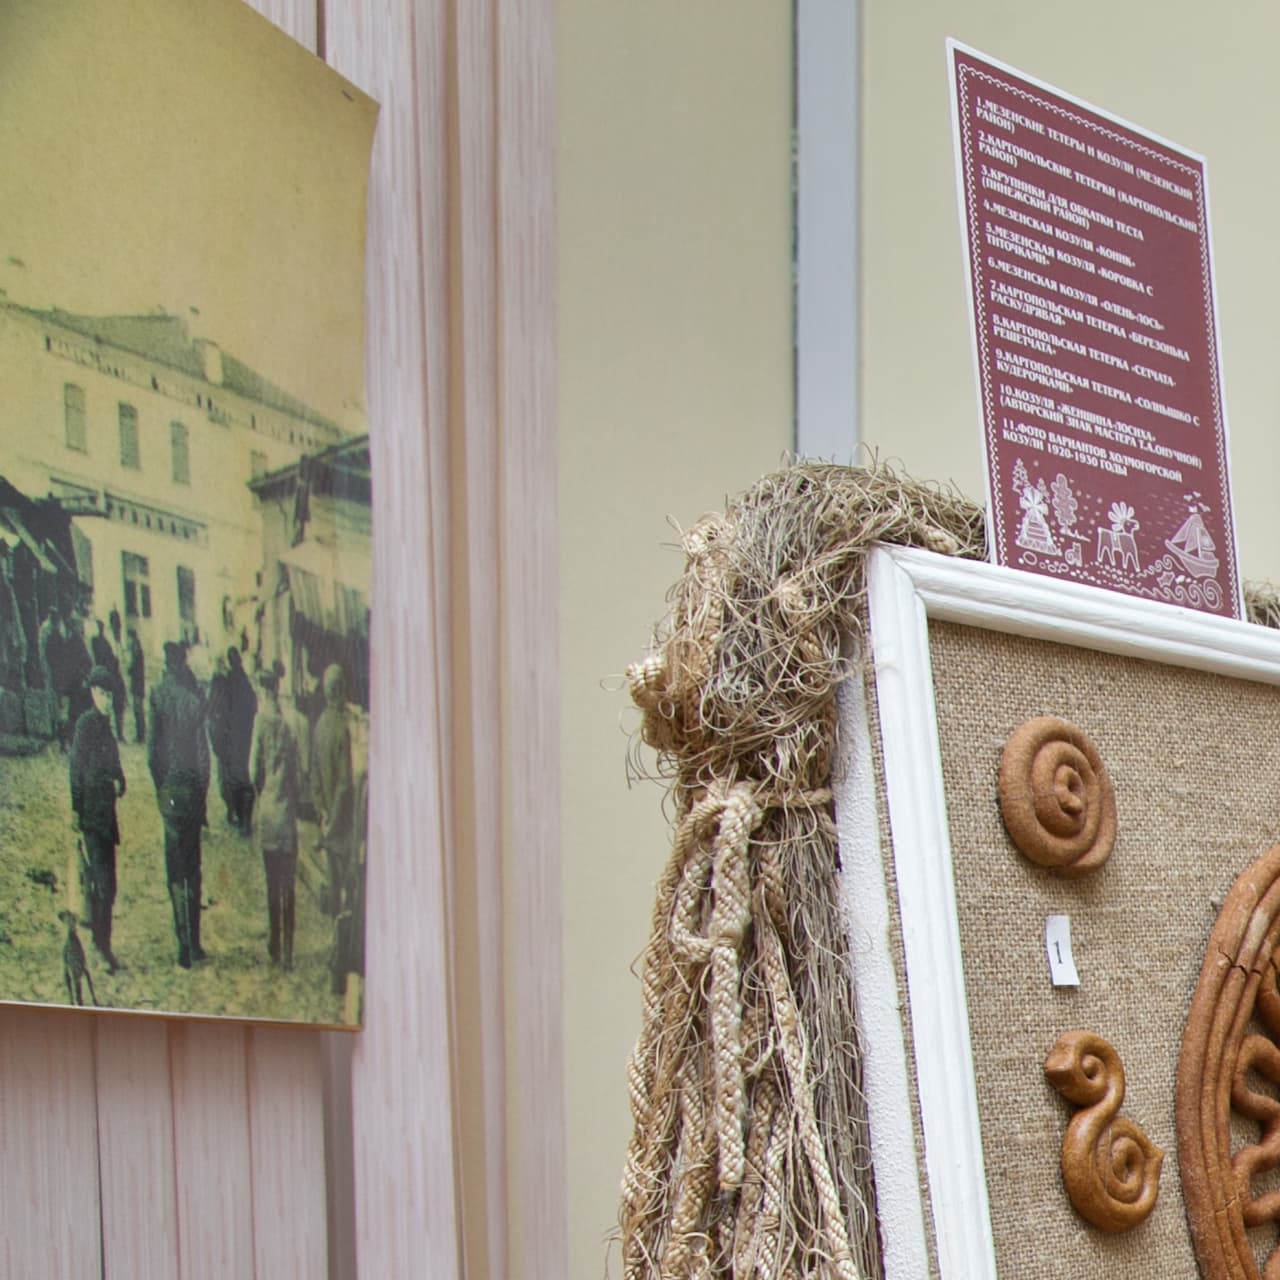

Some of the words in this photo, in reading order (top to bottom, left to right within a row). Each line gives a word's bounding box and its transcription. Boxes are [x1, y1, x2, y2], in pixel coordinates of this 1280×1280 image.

[975, 105, 1015, 135] РАЙОН)
[975, 95, 1045, 135] 1.МЕЗЕНСКИЕ
[1047, 127, 1085, 153] ТЕТЕРЫ
[1086, 144, 1095, 157] И
[1096, 148, 1134, 175] КОЗУЛИ
[1135, 166, 1193, 201] (МЕЗЕНСКИЙ
[977, 140, 1018, 169] РАЙОН)
[977, 129, 1072, 180] 2.КАРГОПОЛЬСКИЕ
[1074, 170, 1116, 198] ТЕТЕРКИ
[1117, 189, 1197, 234] (КАРГОПОЛЬСКИЙ
[980, 174, 1051, 214] (ПИНЕЖСКИЙ
[1052, 203, 1089, 231] РАЙОН)
[982, 197, 1053, 236] 4.МЕЗЕНСКАЯ
[1054, 226, 1093, 252] КОЗУЛЯ
[1046, 191, 1068, 210] ДЛЯ
[1069, 201, 1113, 229] ОБКАТКИ
[1115, 220, 1144, 241] ТЕСТА
[984, 220, 1054, 258] 5.МЕЗЕНСКАЯ
[1056, 249, 1095, 274] КОЗУЛЯ
[1145, 284, 1153, 297] С
[987, 255, 1057, 292] 6.МЕЗЕНСКАЯ
[1059, 282, 1098, 307] КОЗУЛЯ
[989, 278, 1083, 323] 7.КАРГОПОЛЬСКАЯ
[1084, 314, 1126, 339] ТЕТЕРКА
[991, 313, 1086, 356] 8.КАРГОПОЛЬСКАЯ
[1087, 347, 1128, 371] ТЕТЕРКА
[994, 347, 1089, 389] 9.КАРГОПОЛЬСКАЯ
[1090, 380, 1132, 404] ТЕТЕРКА
[1192, 414, 1200, 427] С
[999, 382, 1055, 410] 10.КОЗУЛЯ
[999, 393, 1063, 425] (АВТОРСКИЙ
[1065, 415, 1092, 433] ЗНАК
[1093, 424, 1136, 448] МАСТЕРА
[1002, 417, 1046, 440] 11.ФОТО
[1048, 431, 1107, 459] ВАРИАНТОВ
[1108, 450, 1182, 483] ХОЛМОГОРСКОЙ
[1002, 428, 1043, 451] КОЗУЛИ
[1046, 442, 1098, 467] 1920-1930
[1099, 458, 1127, 477] ГОДЫ
[1053, 940, 1063, 964] 1
